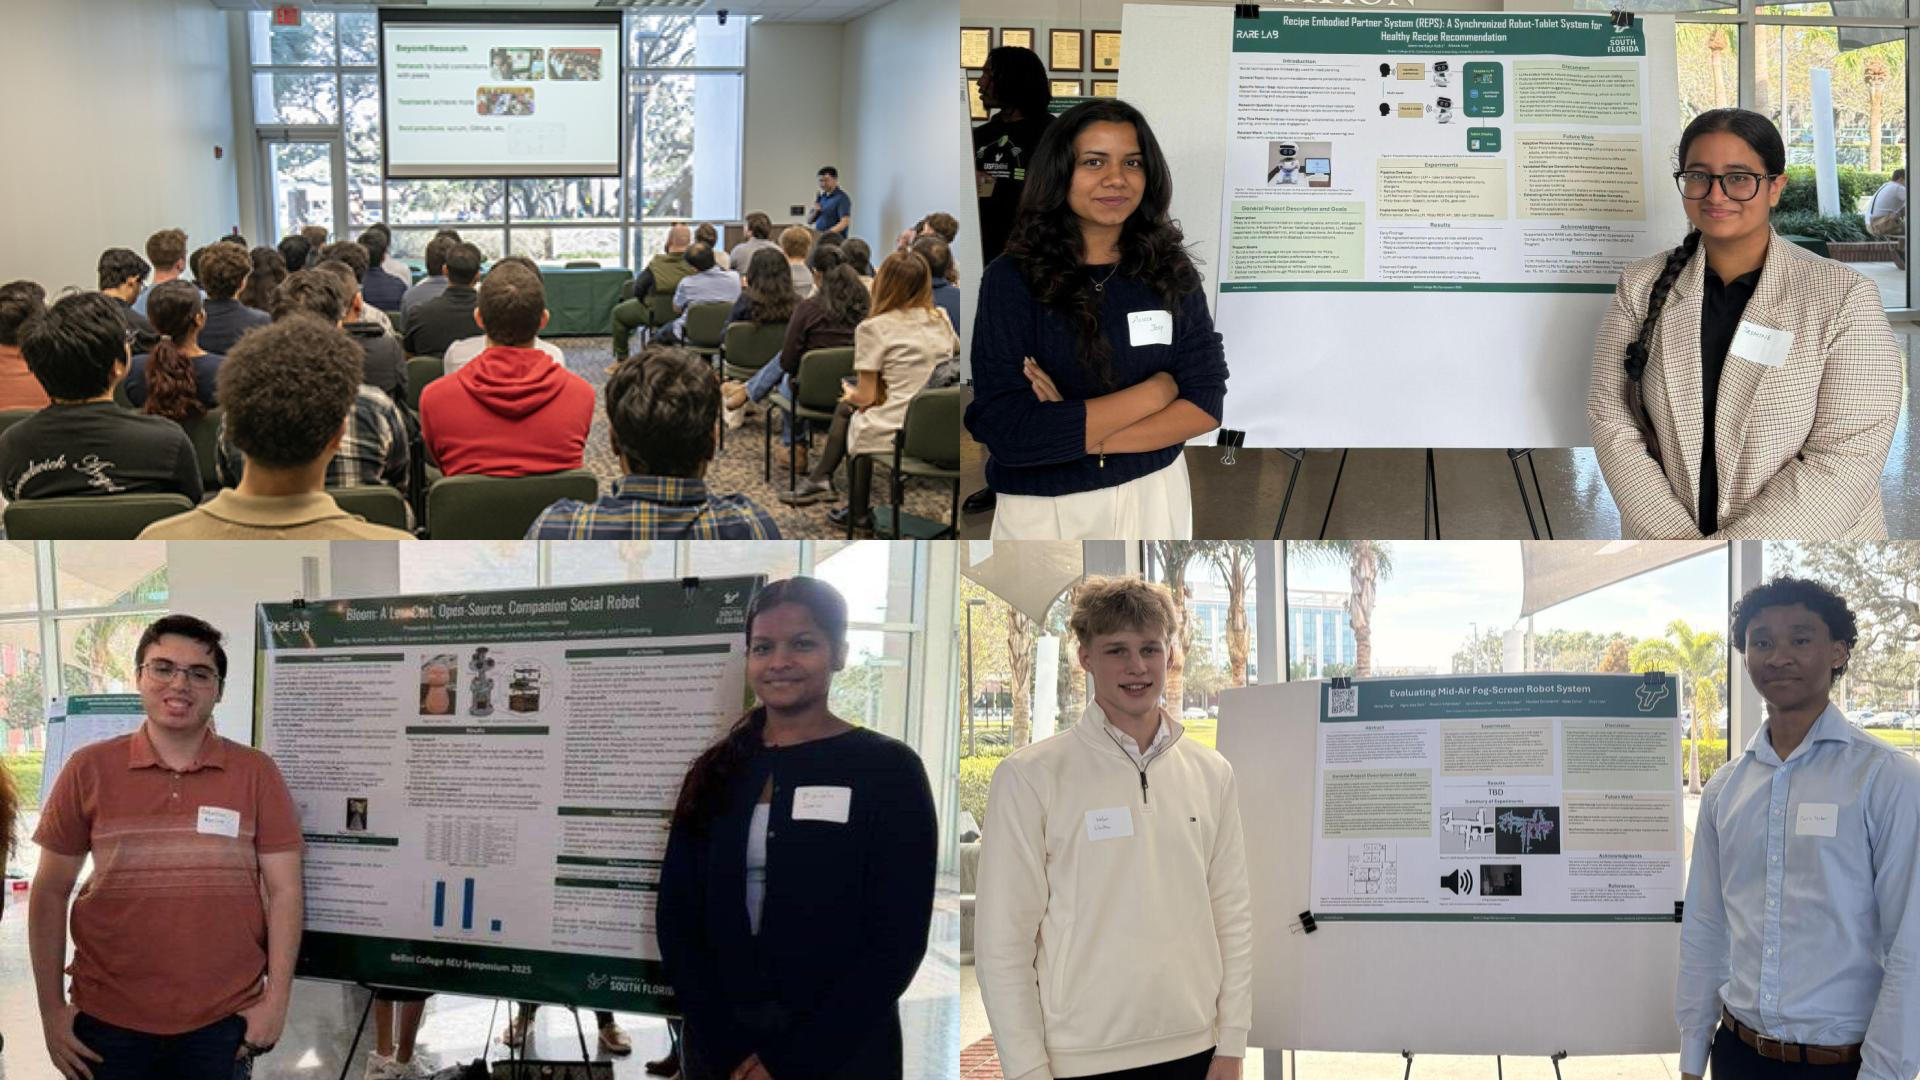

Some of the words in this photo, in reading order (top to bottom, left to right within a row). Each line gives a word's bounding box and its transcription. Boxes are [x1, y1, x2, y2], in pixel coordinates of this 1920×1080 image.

[1283, 16, 1310, 27] Recipe
[1312, 17, 1350, 27] Embodied
[1352, 17, 1381, 28] Partner
[1384, 17, 1413, 29] System
[1416, 17, 1445, 29] (REPS):
[1446, 19, 1452, 28] A
[1454, 18, 1507, 30] Synchronized
[1509, 19, 1559, 29] Robot-Tablet
[1561, 19, 1589, 30] System
[1591, 20, 1603, 30] for
[1236, 31, 1260, 39] RARE
[1261, 30, 1279, 39] LAB
[1381, 31, 1410, 43] Healthy
[1412, 32, 1439, 43] Recipe
[1440, 32, 1507, 42] Recommendation
[429, 44, 468, 52] Research
[389, 604, 435, 620] LoCost,
[509, 598, 567, 616] Companion
[570, 596, 603, 612] Social
[606, 594, 640, 610] Robot
[1389, 688, 1436, 698] Evaluating
[1438, 687, 1470, 696] Mid-Air
[1472, 686, 1525, 697] Fog-Screen
[1526, 684, 1554, 694] Robot
[1556, 684, 1591, 695] System
[1488, 788, 1504, 796] TBD
[463, 958, 509, 973] Symposium
[609, 980, 640, 993] SOUTH
